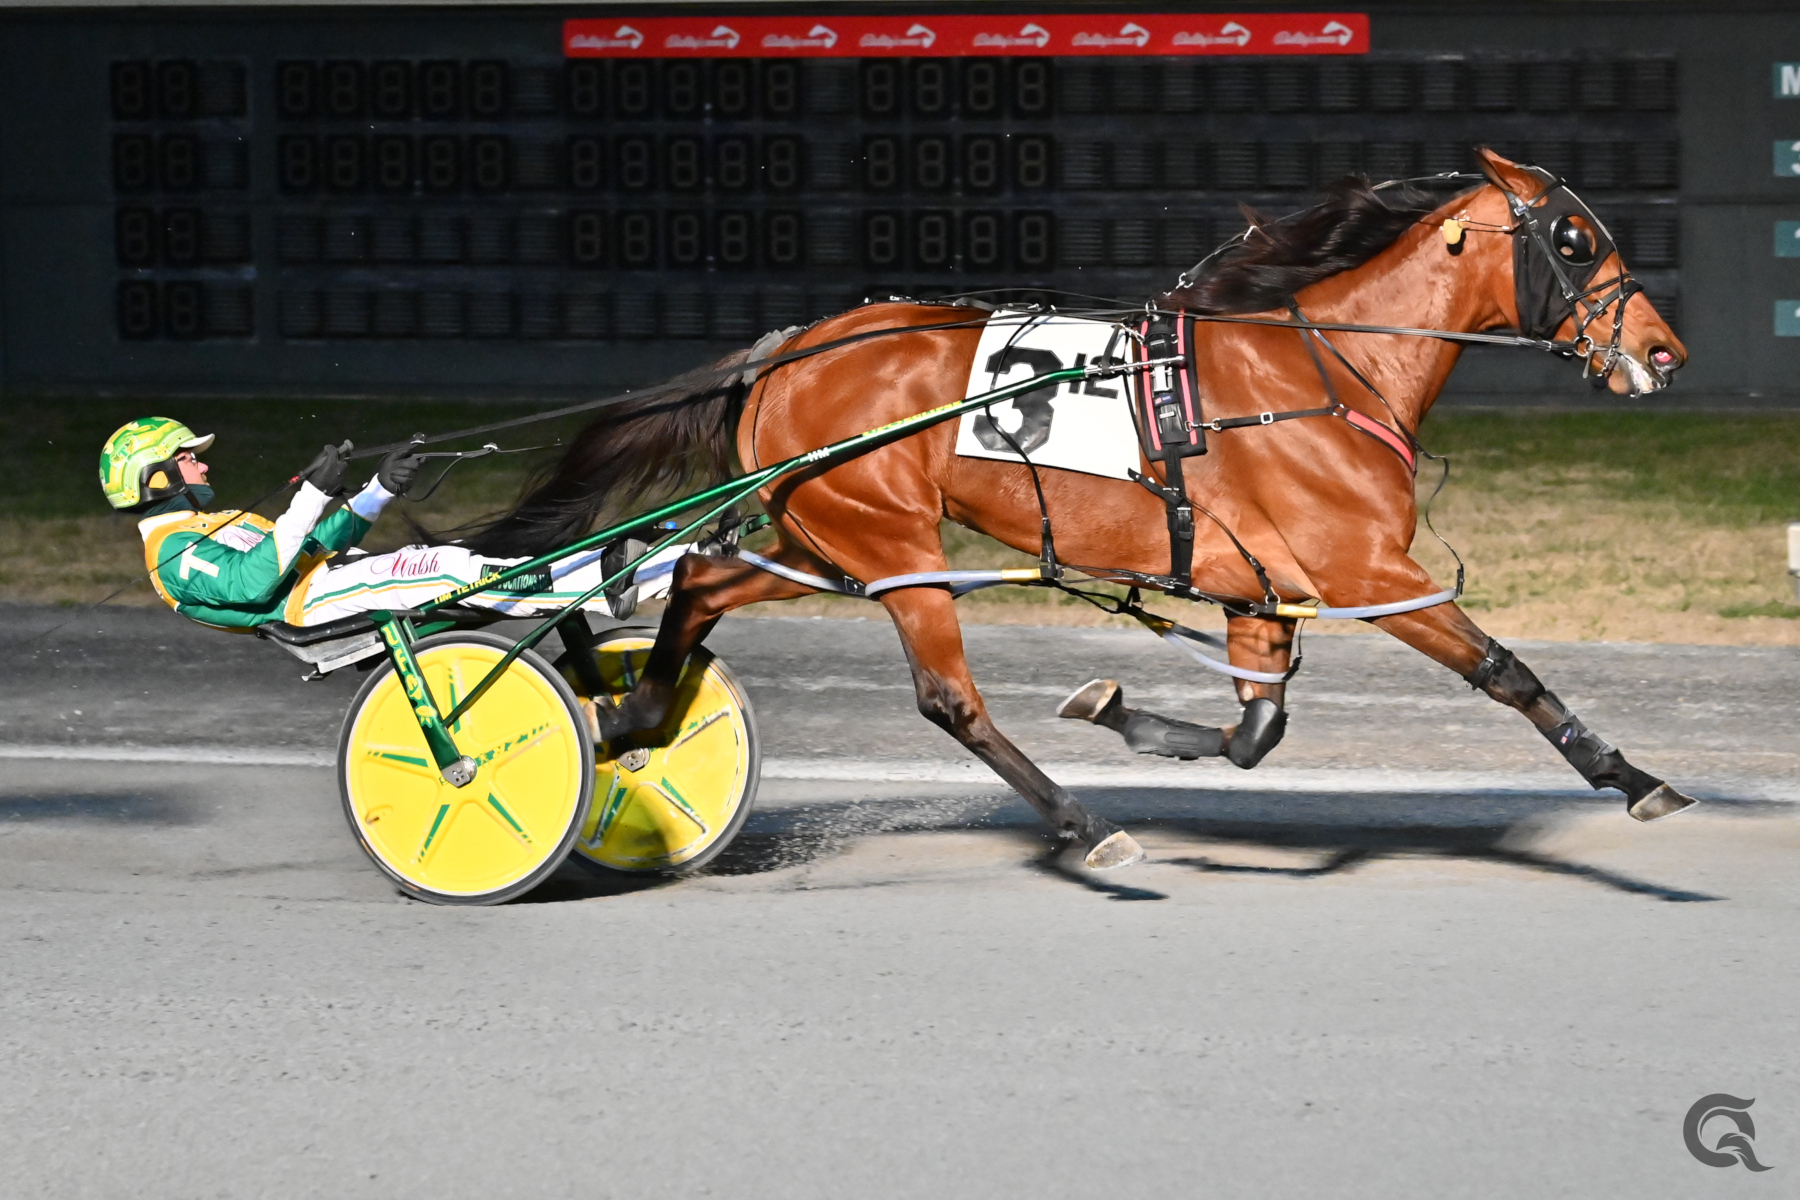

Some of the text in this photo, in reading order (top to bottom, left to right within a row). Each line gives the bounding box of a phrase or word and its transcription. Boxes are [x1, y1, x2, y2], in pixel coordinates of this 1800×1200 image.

[972, 345, 1128, 456] 3 12
[179, 541, 220, 580] T
[370, 551, 441, 577] Walsh
[434, 591, 452, 605] TIM
[456, 571, 501, 595] TETRICK
